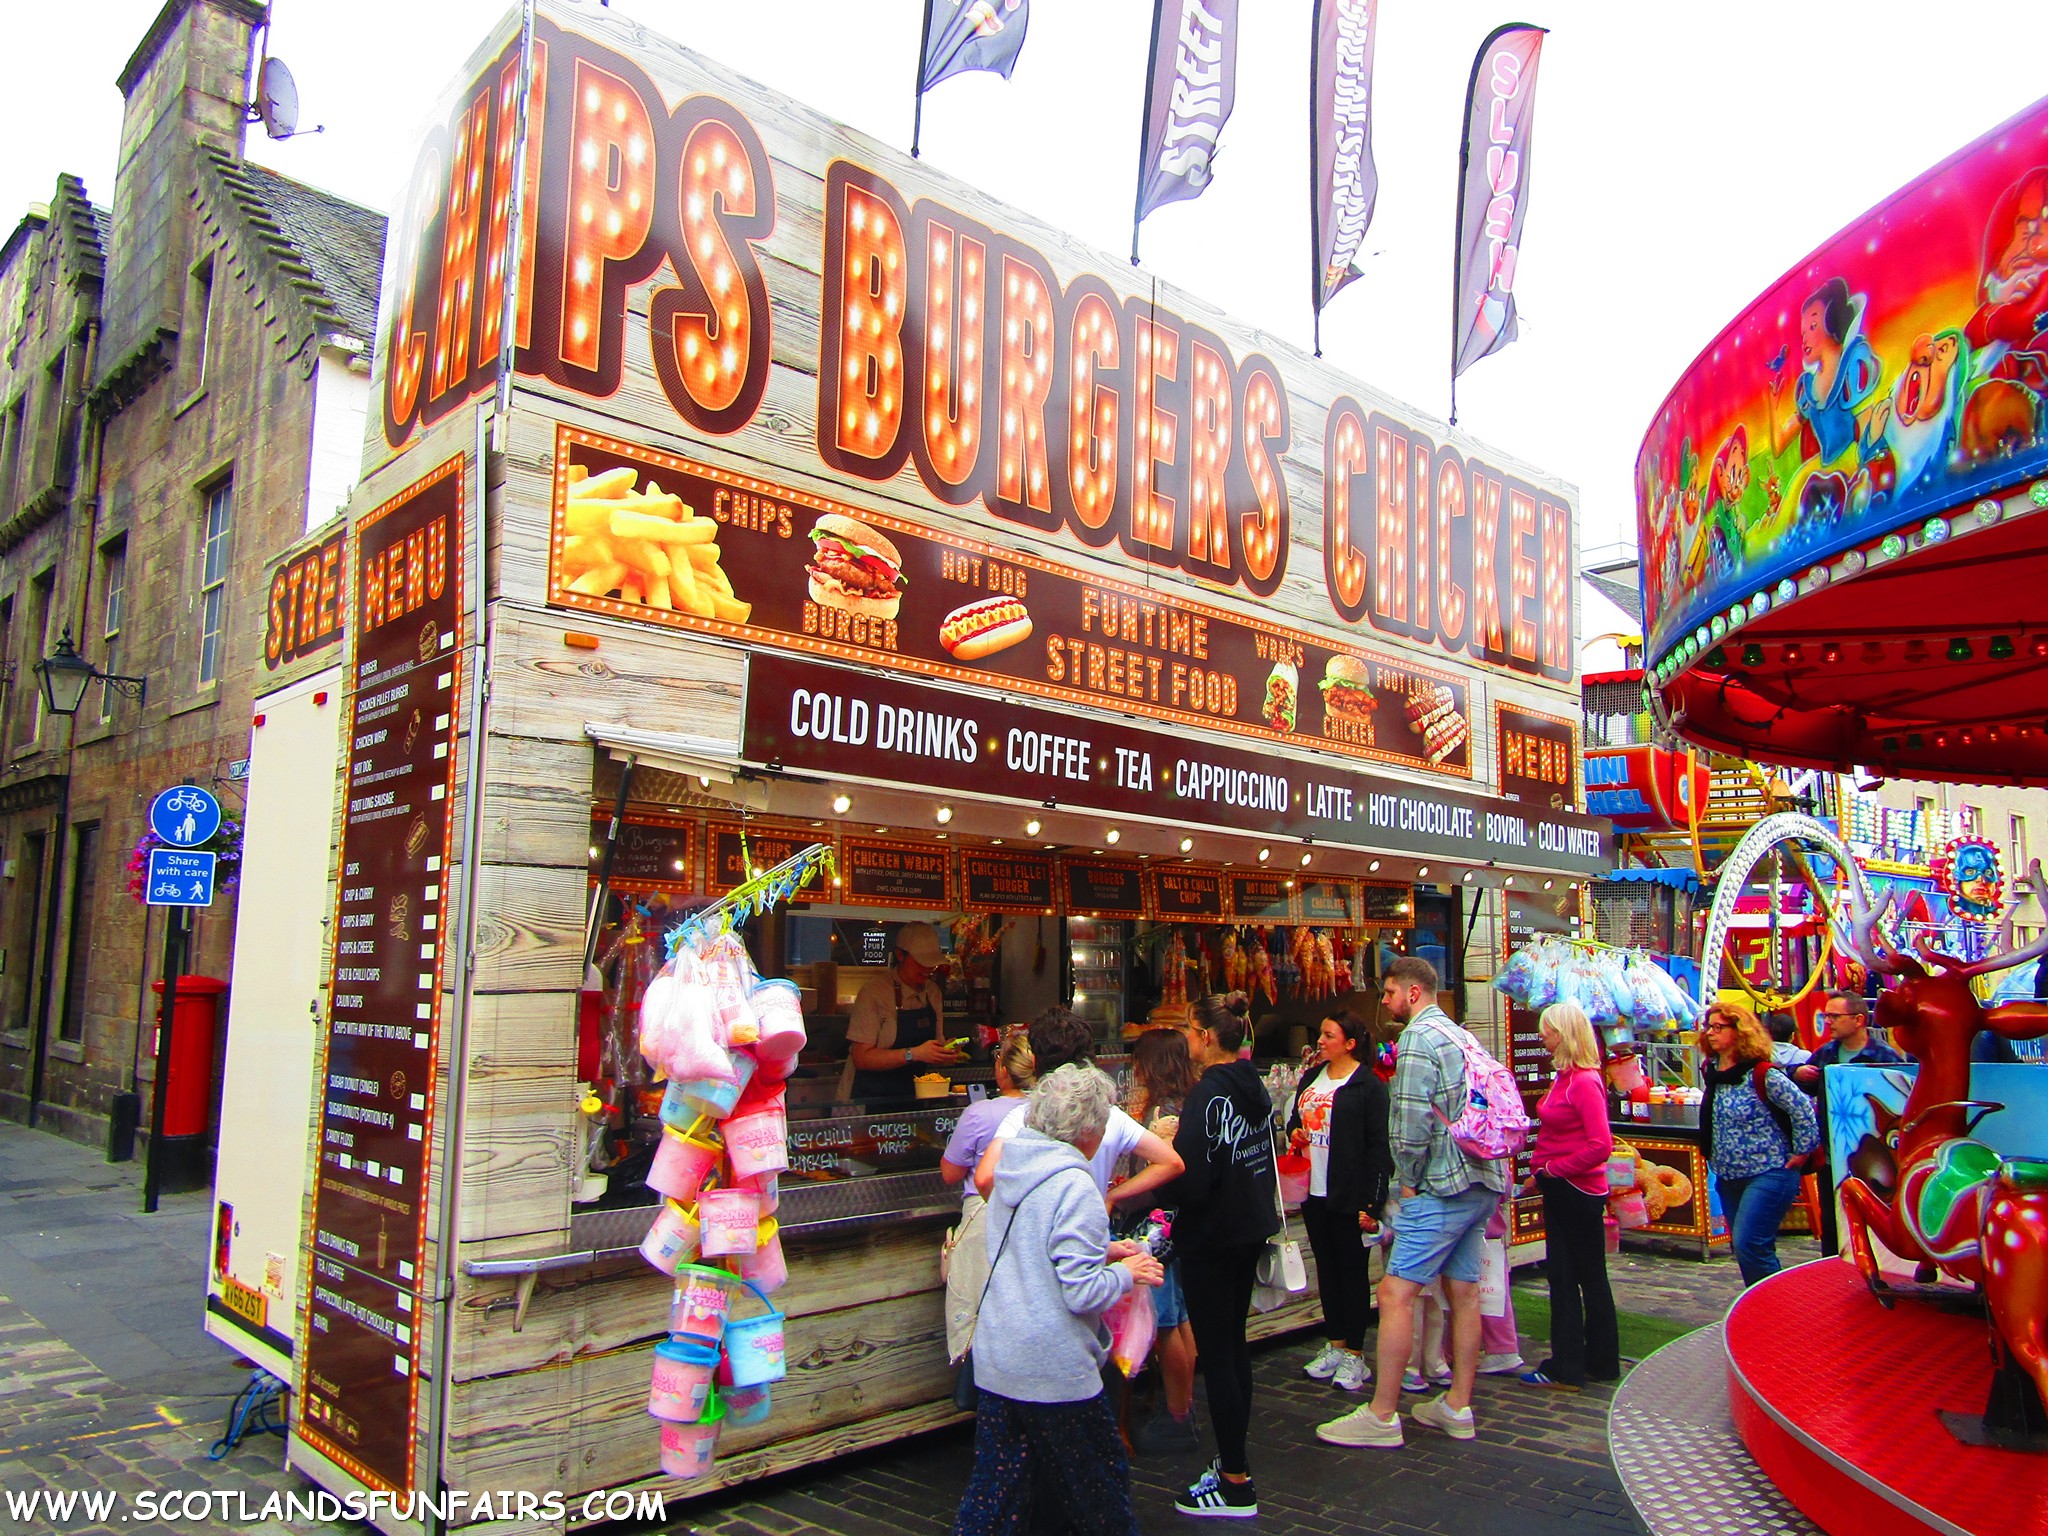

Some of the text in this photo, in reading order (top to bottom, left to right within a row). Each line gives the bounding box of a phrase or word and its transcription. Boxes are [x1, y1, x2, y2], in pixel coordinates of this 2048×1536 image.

[1484, 50, 1521, 292] SLUSH
[826, 170, 1286, 590] BURGERS
[1329, 405, 1570, 677] CHICKEN
[713, 488, 793, 539] CHIPS
[363, 514, 447, 633] MENU
[942, 549, 1029, 598] HOT DOG
[802, 599, 898, 651] BURGER
[1083, 586, 1209, 660] FUNTIME
[1255, 633, 1305, 668] WRAPS
[360, 660, 378, 677] BURGER
[1046, 633, 1238, 717] STREET FOOD
[1376, 667, 1436, 699] FOOT LONG
[358, 696, 375, 713] CHICKEN
[390, 684, 408, 702] BURGER
[356, 729, 388, 749] CHICKEN WRAP
[1323, 715, 1375, 747] CHICKEN
[1505, 729, 1567, 785] MENU
[353, 759, 372, 775] HOT DOG
[790, 688, 1600, 858] COLD DRINKS COFFEE TEA CAPPUCCINO LATTE HOT CHOCOLATE BOVRIL COLD WATER
[1506, 792, 1520, 802] BURGER
[1585, 788, 1652, 815] HEEL
[755, 841, 792, 858] CHIPS
[168, 855, 200, 867] Share
[346, 863, 359, 875] CHIPS
[853, 850, 943, 872] CHICKEN WRAPS
[156, 866, 209, 878] with care
[971, 861, 1047, 880] CHICKEN FILLET
[1088, 870, 1126, 885] BURGERS
[993, 878, 1029, 893] BURGER
[1163, 876, 1215, 892] SALT & CHILLI
[1246, 882, 1259, 894] HOT
[344, 889, 354, 901] CHIP
[359, 887, 374, 900] CURRY
[1179, 890, 1201, 904] CHIPS
[342, 915, 355, 927] CHIPS
[359, 914, 374, 926] GRAVY
[1509, 910, 1521, 919] CHIPS
[340, 942, 353, 953] CHIPS
[357, 941, 374, 953] CHEESE
[366, 968, 380, 981] CHIPS
[334, 1021, 346, 1034] CHIPS
[395, 1026, 412, 1040] ABOVE
[736, 1126, 778, 1144] CANDY
[750, 1134, 783, 1149] FLOSS
[786, 1133, 812, 1151] NEY
[877, 1140, 910, 1154] WRAP
[713, 1205, 756, 1222] CANDY
[726, 1217, 757, 1229] FLOSS
[685, 1285, 728, 1300] CANDY
[695, 1295, 727, 1310] FLOSS
